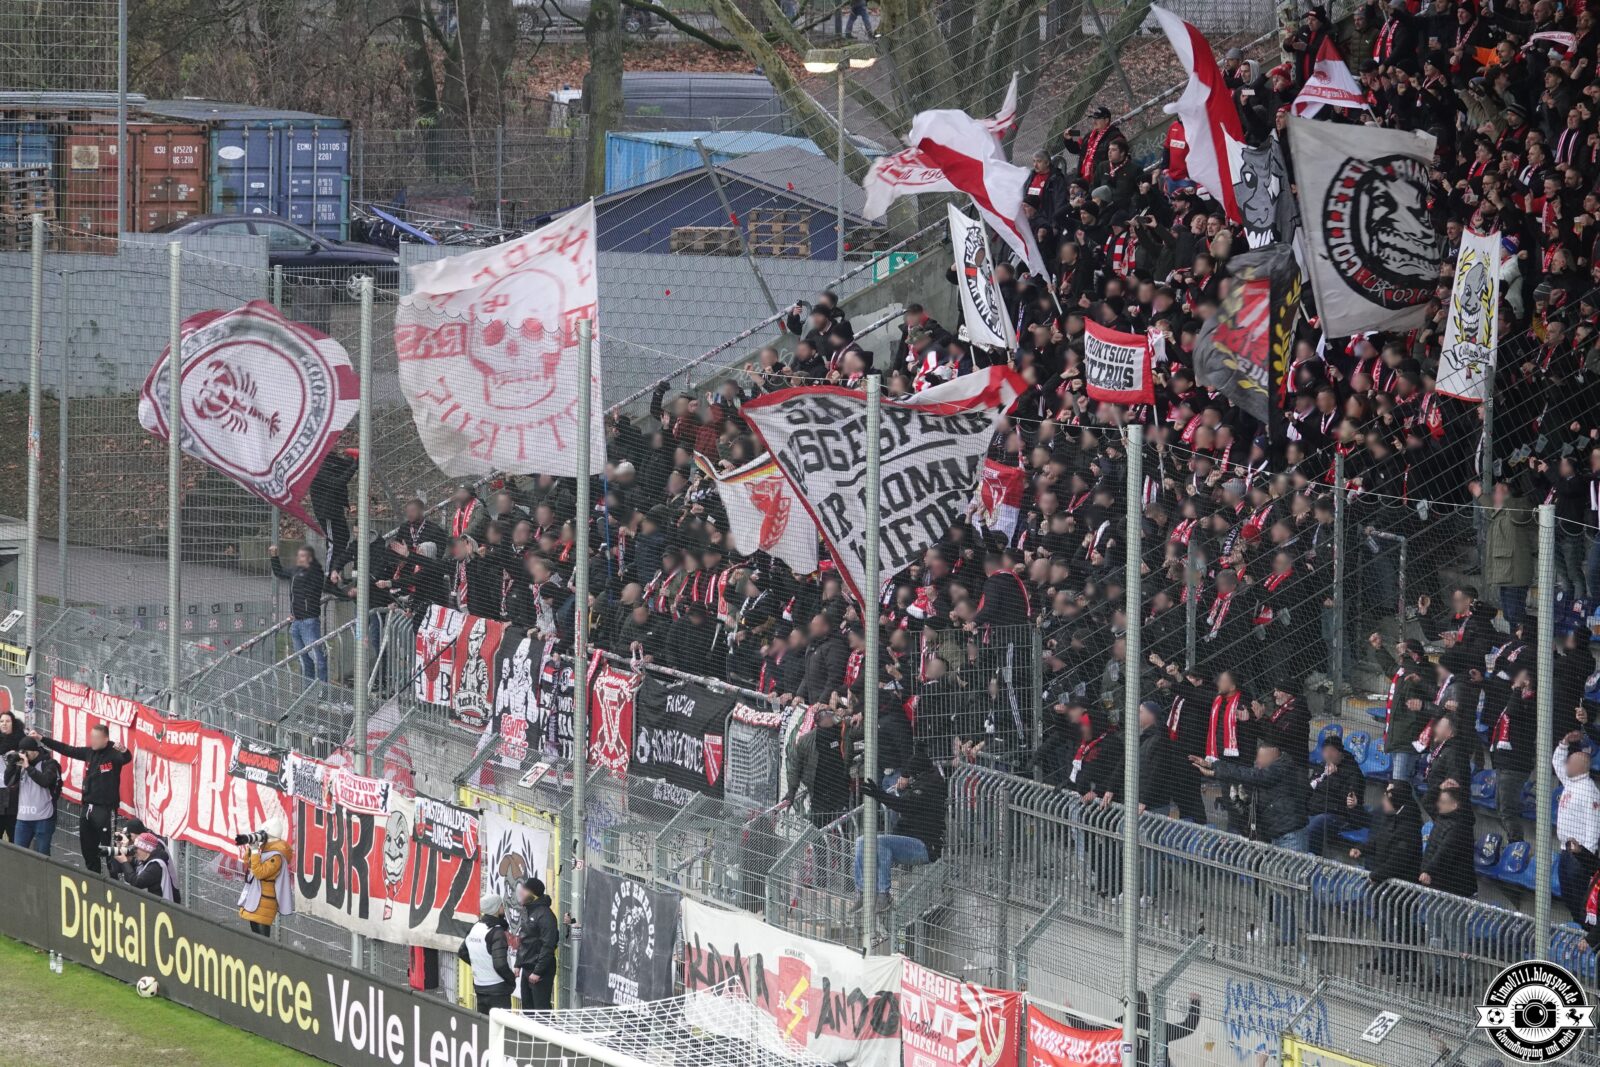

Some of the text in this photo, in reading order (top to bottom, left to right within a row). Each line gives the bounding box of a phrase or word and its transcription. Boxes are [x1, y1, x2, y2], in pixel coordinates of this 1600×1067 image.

[1086, 335, 1136, 365] FRONTSIDE
[1086, 356, 1134, 388] TTBUS
[166, 729, 200, 747] FRONT
[431, 822, 454, 850] JUNGS
[620, 880, 632, 898] OF
[60, 874, 147, 967] Digital
[153, 910, 321, 1035] Commerce.
[326, 973, 405, 1065] Volle
[902, 961, 959, 1005] ENERGIE
[607, 972, 639, 998] COTTBUS
[1366, 1015, 1396, 1038] 25
